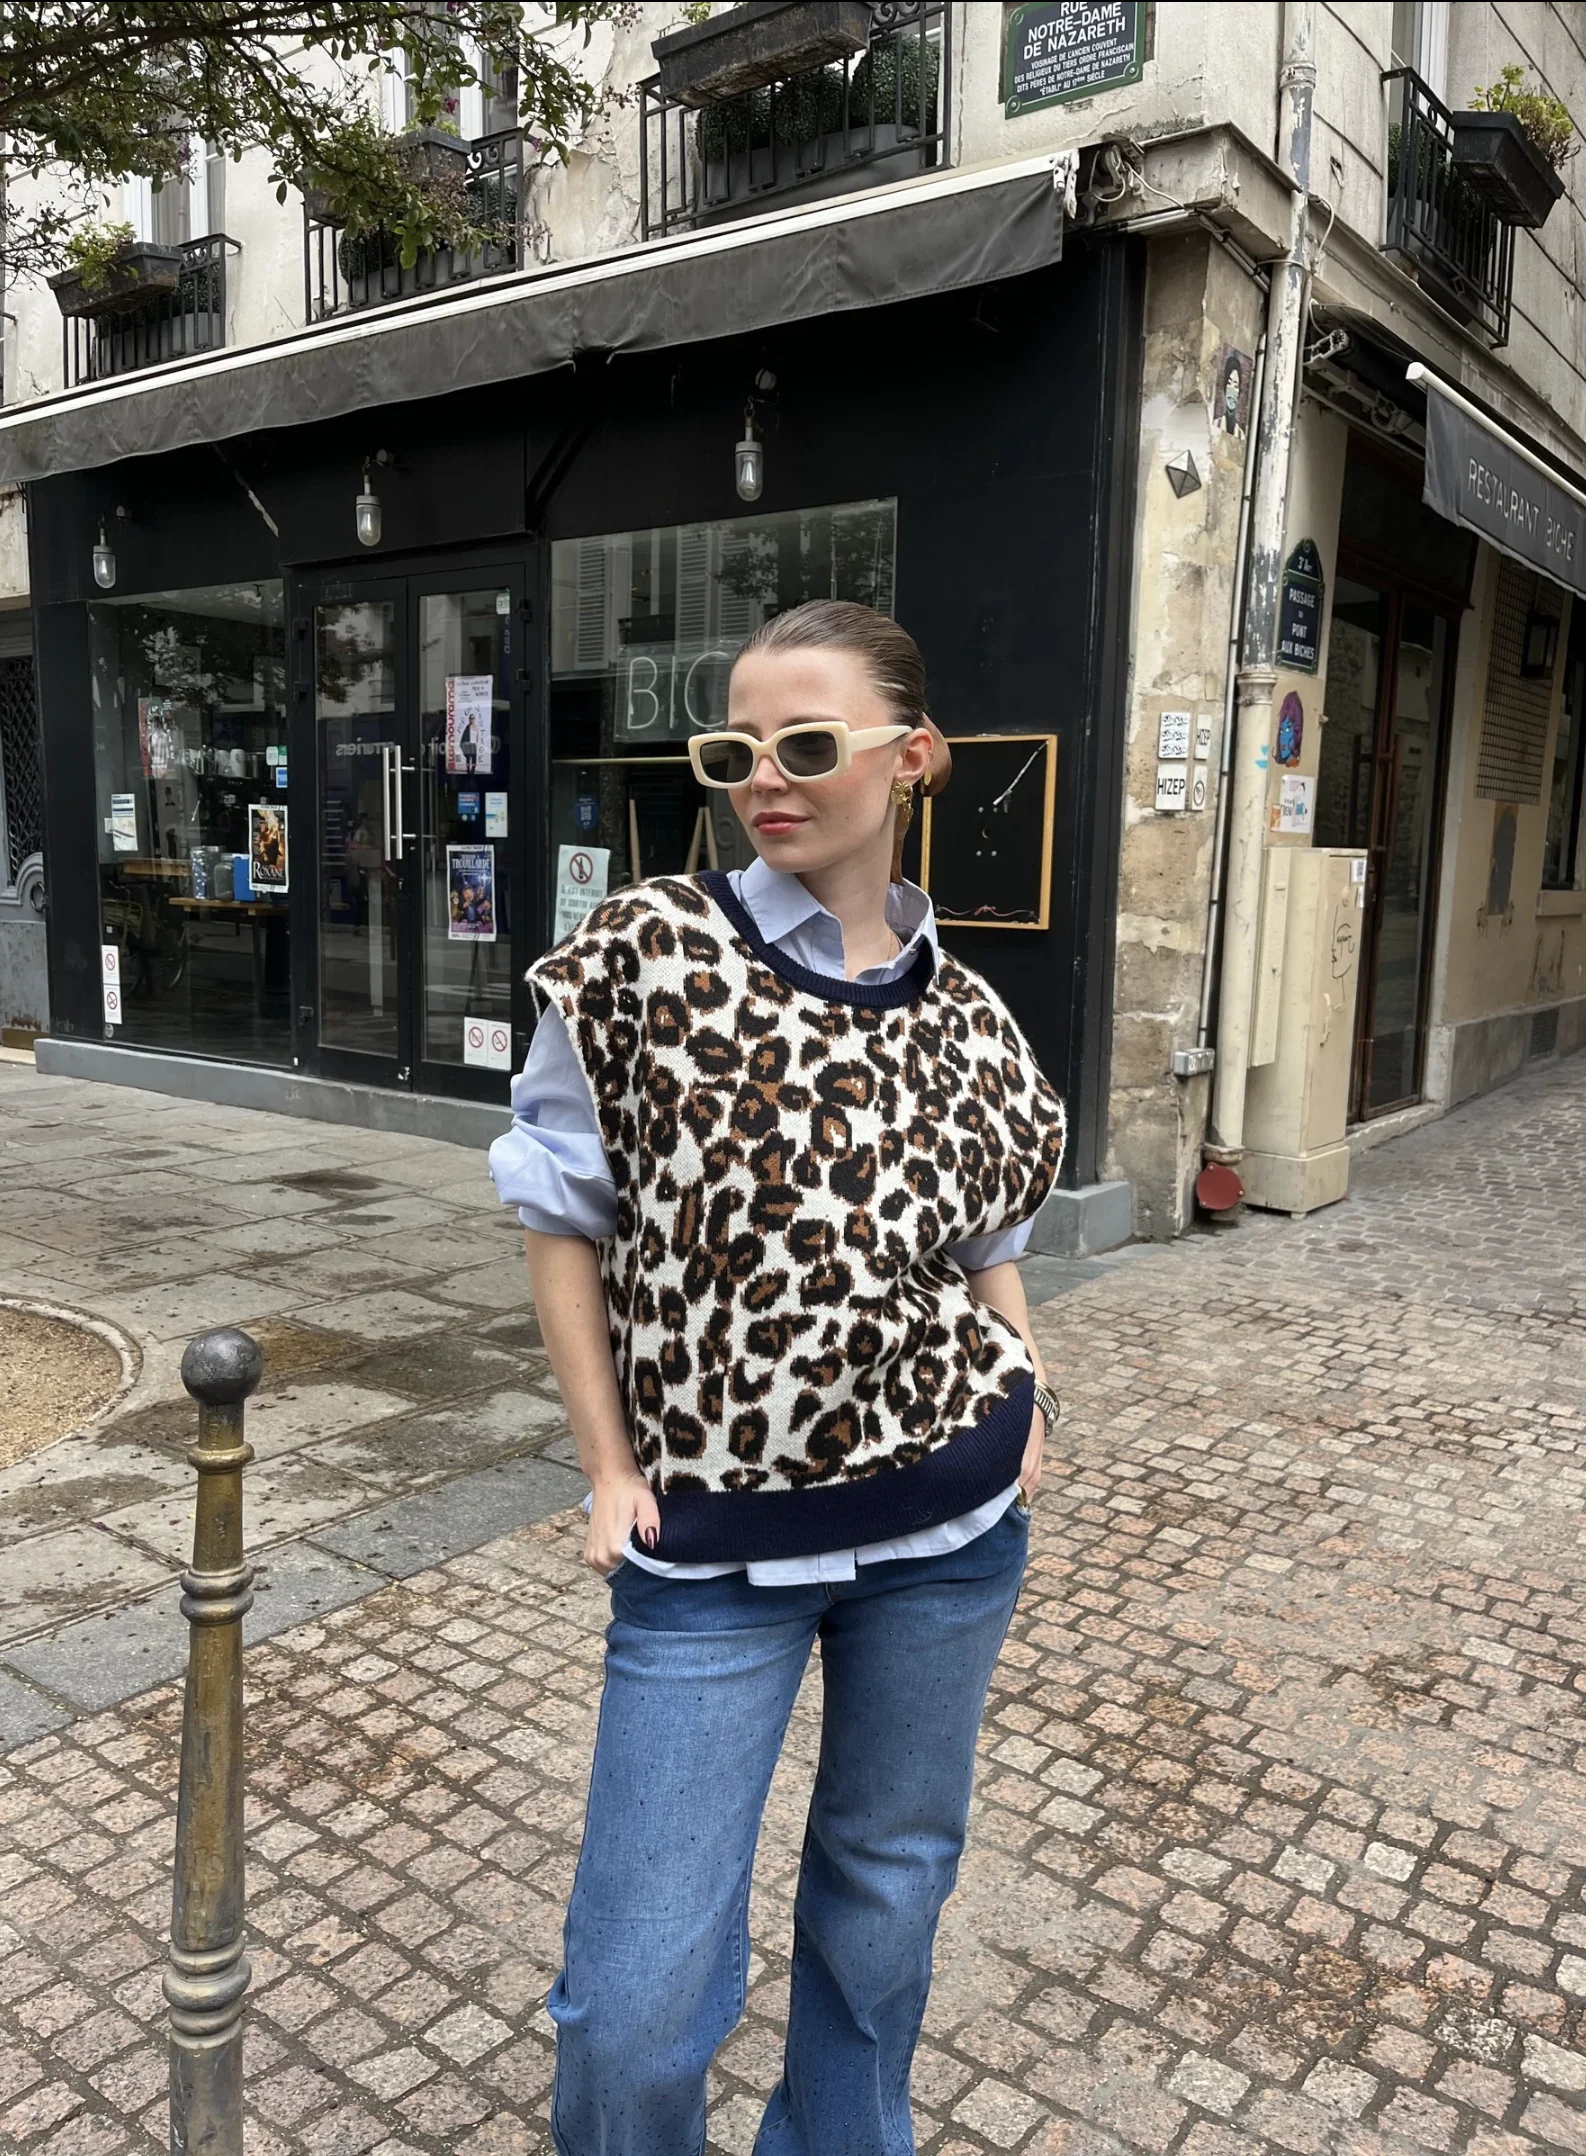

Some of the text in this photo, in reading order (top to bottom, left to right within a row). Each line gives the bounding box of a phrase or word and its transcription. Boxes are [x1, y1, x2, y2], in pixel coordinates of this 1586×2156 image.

[1028, 2, 1122, 43] NOTRE-DAME
[1061, 2, 1088, 17] RUE
[1024, 16, 1126, 60] DE NAZARETH
[1031, 55, 1058, 69] VOISINAGE
[1059, 52, 1066, 61] DE
[1091, 37, 1117, 51] COUVENT
[1014, 74, 1025, 84] DES
[1026, 66, 1052, 80] RELIGIEUX
[1053, 63, 1061, 72] DU
[1062, 58, 1077, 69] TIERS
[1079, 52, 1097, 64] ORDRE
[1017, 82, 1029, 93] DITS
[1048, 74, 1056, 84] DE
[1056, 64, 1091, 81] NOTRE-DAME
[1092, 61, 1100, 71] DE
[1101, 53, 1131, 69] NAZARETH
[1063, 80, 1071, 89] AU
[1468, 458, 1540, 536] RESTAURANT
[1289, 588, 1315, 608] PASSAGE
[1292, 623, 1307, 638] PONT
[1281, 639, 1315, 660] AUX BICHES
[1156, 778, 1186, 796] HIZEP
